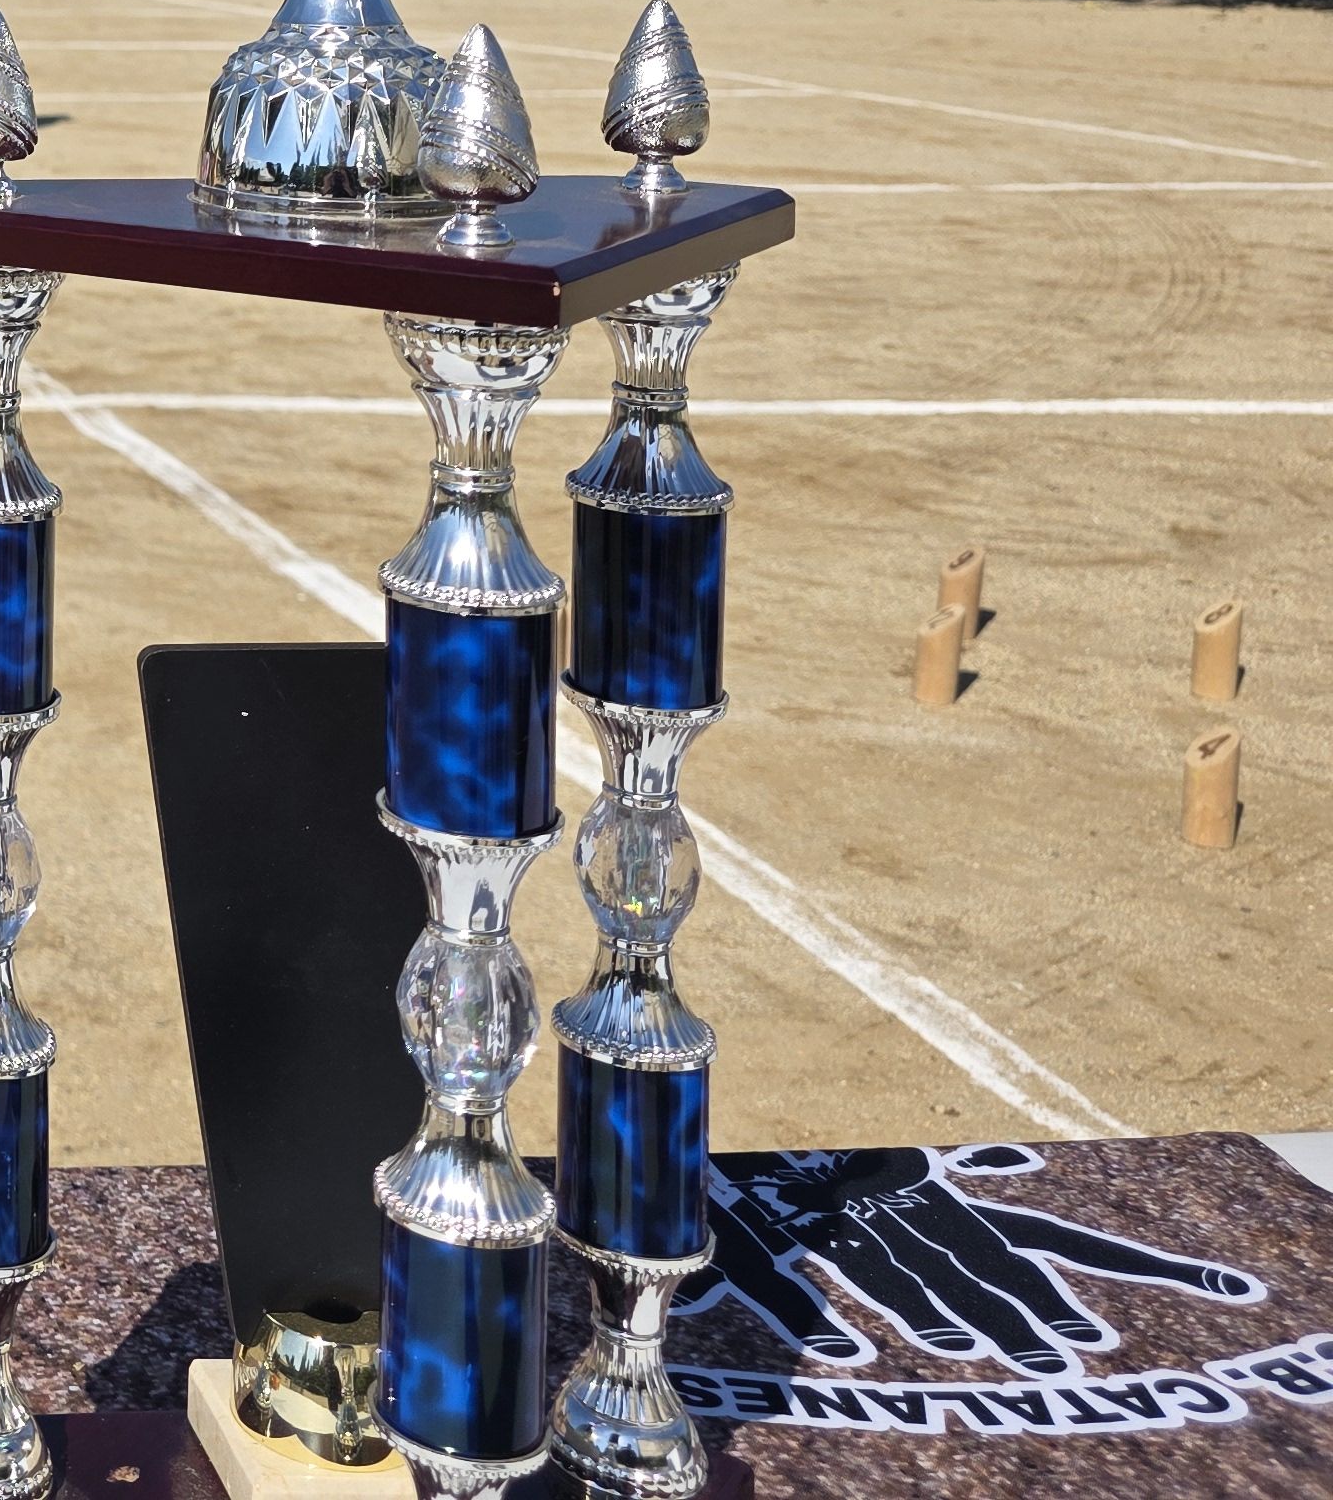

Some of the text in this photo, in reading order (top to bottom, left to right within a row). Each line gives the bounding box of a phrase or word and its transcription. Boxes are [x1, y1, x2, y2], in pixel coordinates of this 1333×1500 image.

[1203, 602, 1234, 625] 8
[1197, 733, 1232, 760] 4
[667, 1371, 1230, 1426] CATALANES
